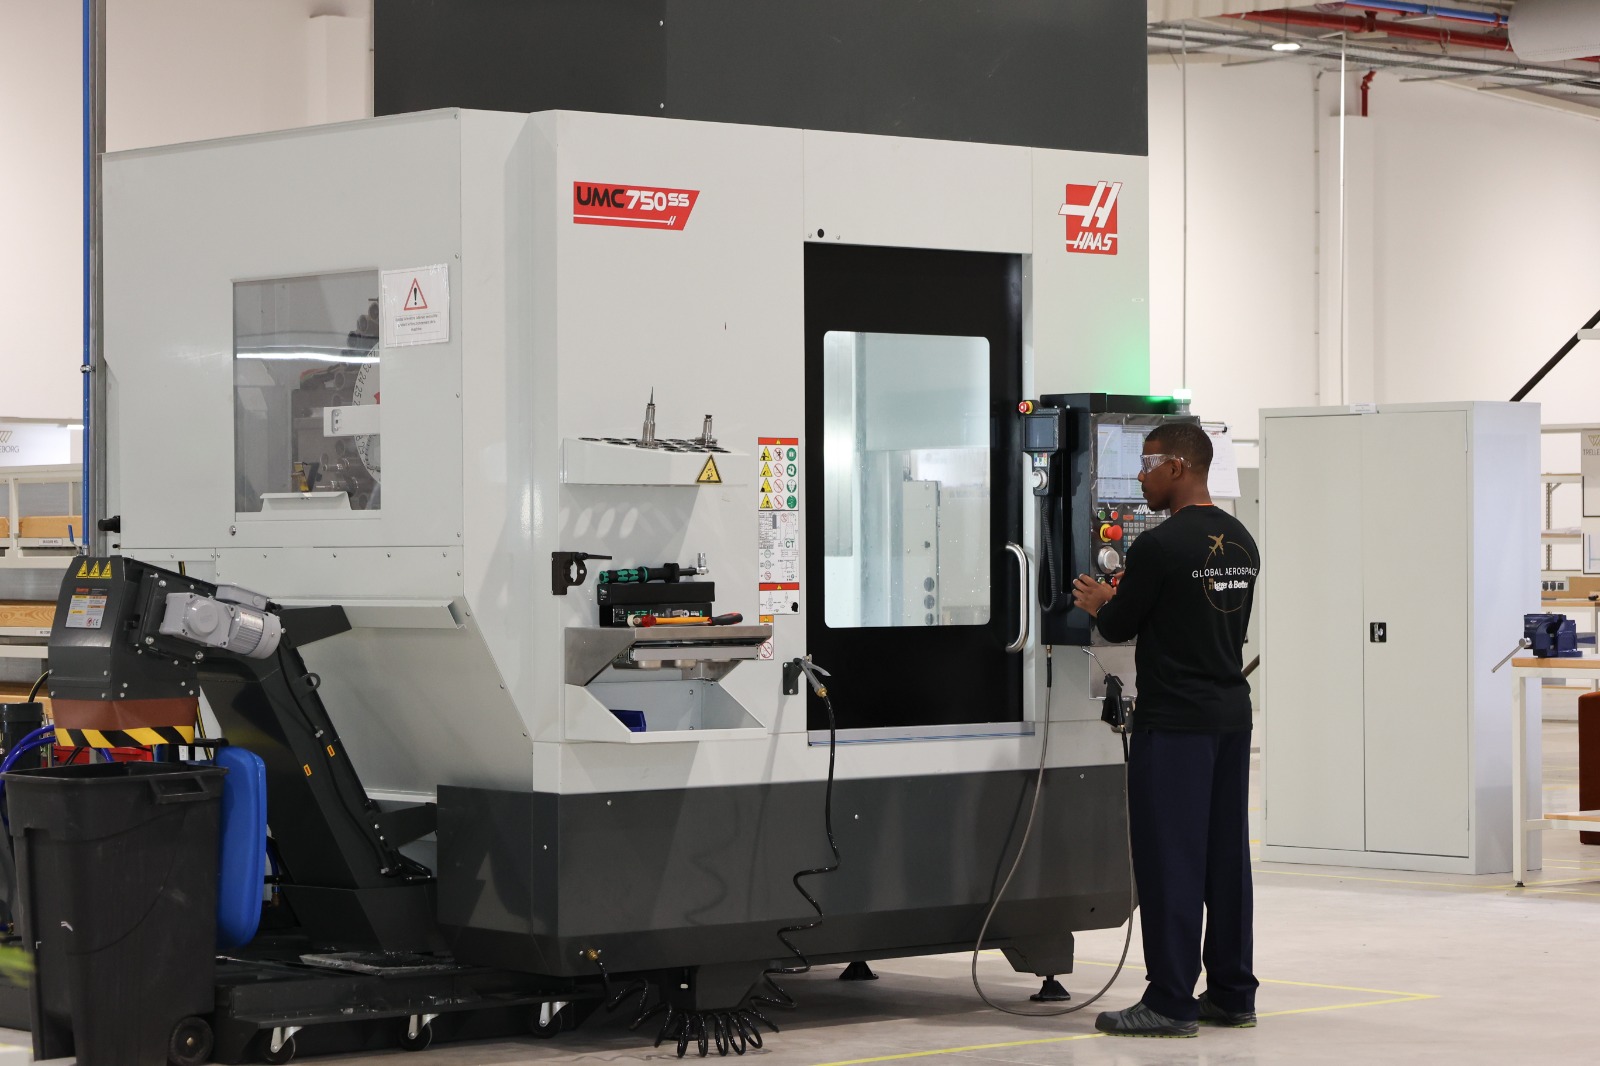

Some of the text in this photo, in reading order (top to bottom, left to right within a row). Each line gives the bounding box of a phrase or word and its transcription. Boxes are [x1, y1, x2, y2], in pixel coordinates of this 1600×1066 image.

[1066, 231, 1118, 251] HAAS
[354, 385, 362, 398] 25
[1192, 568, 1223, 578] GLOBAL
